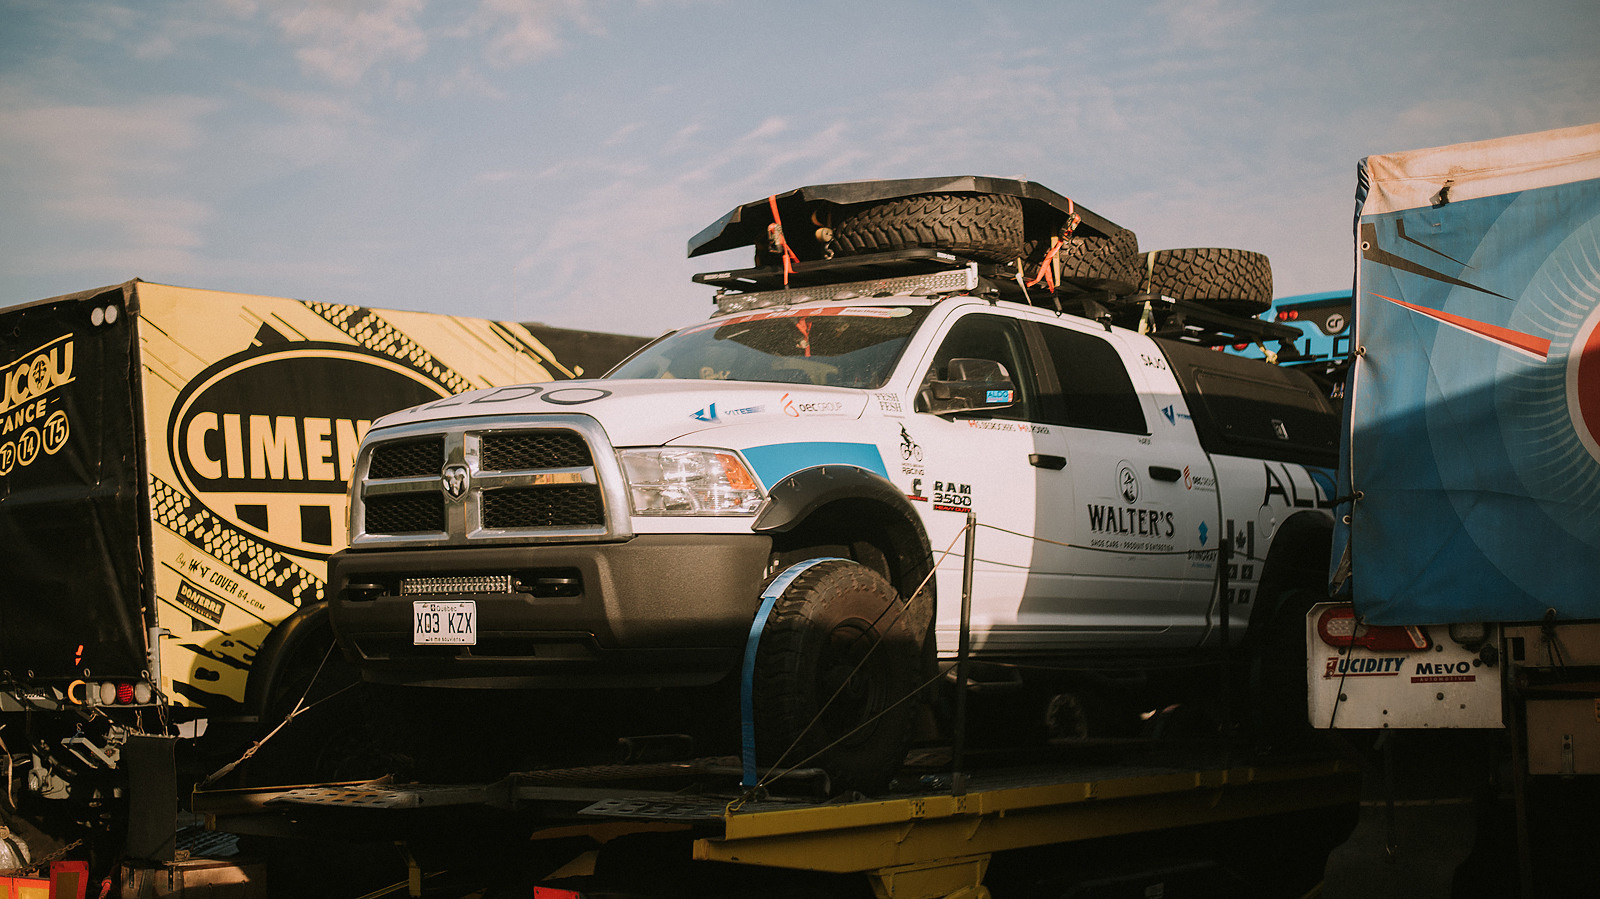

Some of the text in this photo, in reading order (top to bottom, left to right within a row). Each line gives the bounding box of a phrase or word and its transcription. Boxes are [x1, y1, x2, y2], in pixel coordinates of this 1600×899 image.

[0, 397, 47, 435] ANCE
[879, 401, 903, 413] FESH
[22, 436, 34, 460] T4
[49, 417, 65, 446] T5
[933, 481, 972, 495] RAM
[933, 492, 972, 507] 3500
[1087, 504, 1175, 538] WALTER'S
[209, 572, 239, 595] COVER
[416, 612, 472, 634] X03 KZX
